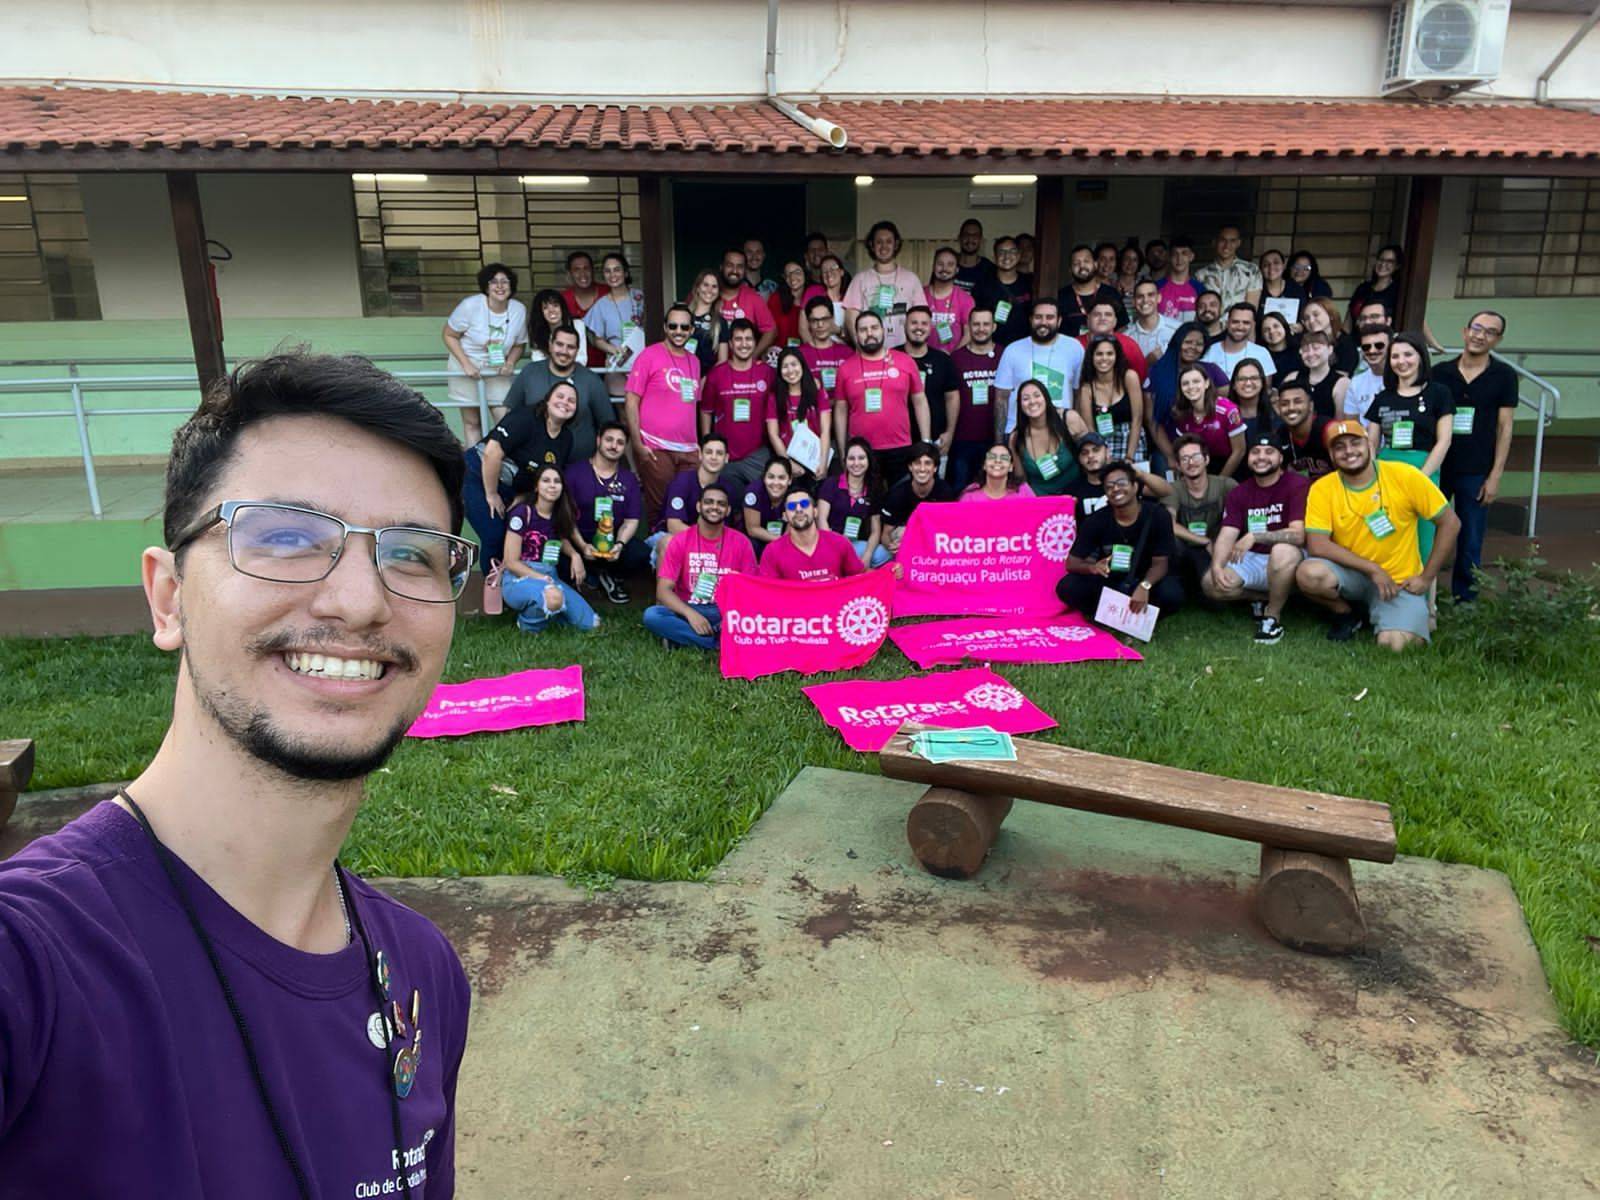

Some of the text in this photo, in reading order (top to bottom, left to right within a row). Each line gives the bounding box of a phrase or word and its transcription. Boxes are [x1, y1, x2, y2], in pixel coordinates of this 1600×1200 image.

[934, 532, 1032, 554] Rotaract
[911, 555, 939, 566] Clube
[982, 556, 998, 565] do
[999, 554, 1033, 566] Rotary
[910, 568, 1032, 586] Paraguaçu Paulista
[727, 609, 833, 635] Rotaract
[754, 635, 767, 645] de
[837, 700, 968, 723] Rotaract
[355, 1180, 380, 1199] Club
[382, 1178, 395, 1194] de
